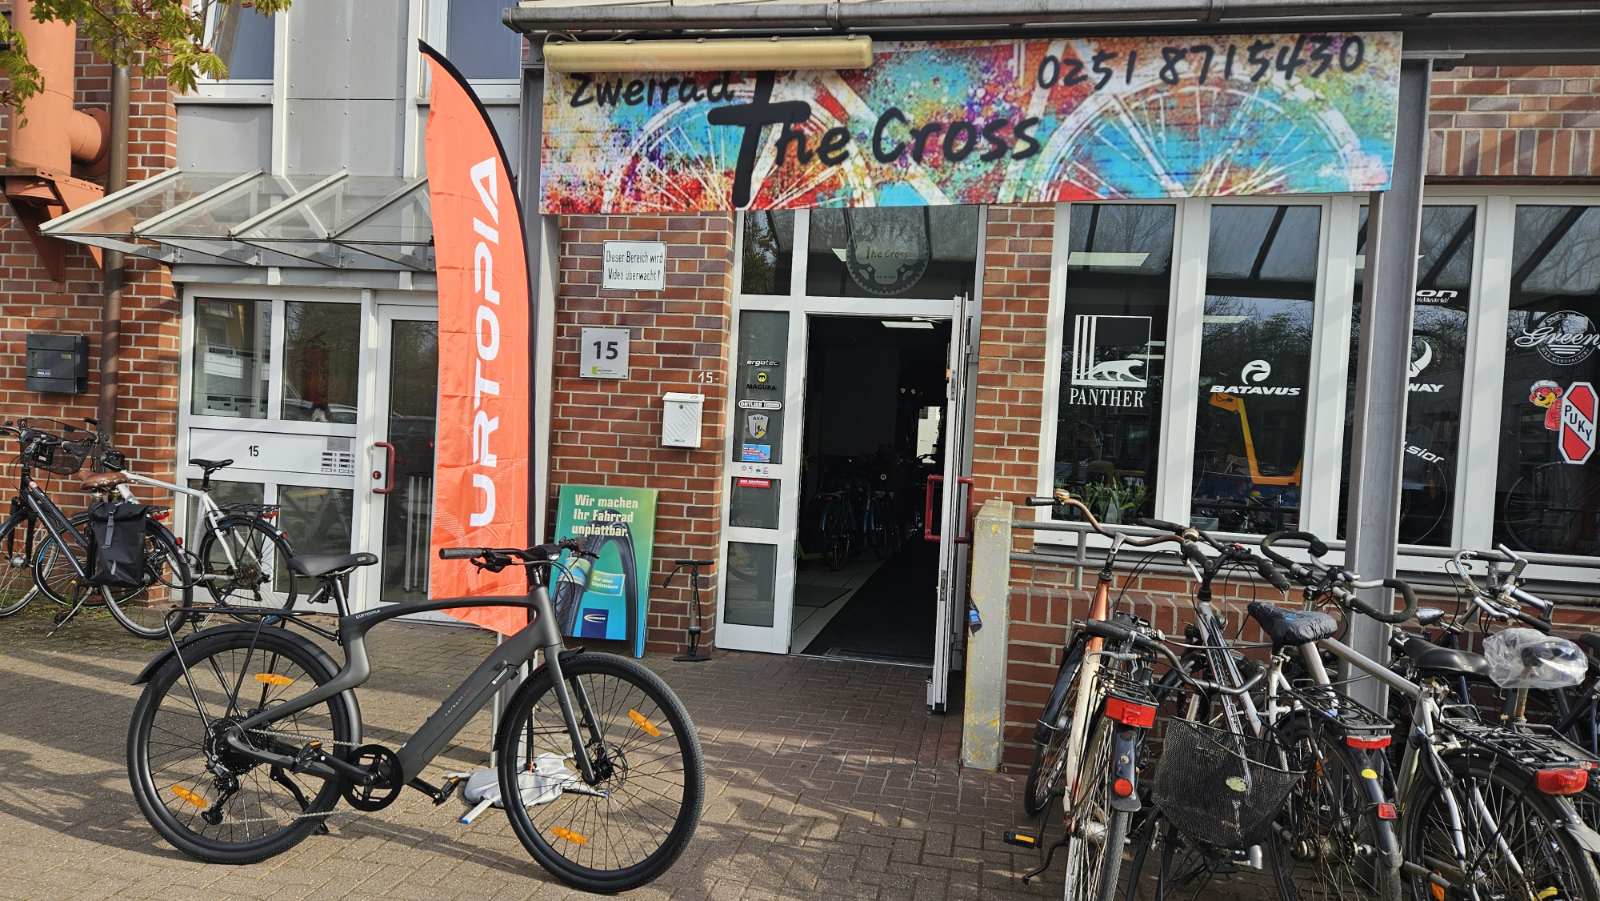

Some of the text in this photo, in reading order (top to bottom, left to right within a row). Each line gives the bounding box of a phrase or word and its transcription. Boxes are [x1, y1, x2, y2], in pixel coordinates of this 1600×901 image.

[1037, 35, 1366, 91] 0251 8715430
[569, 70, 736, 108] Zweirad
[707, 70, 1042, 208] The Cross
[626, 250, 649, 264] Bereich
[469, 156, 500, 527] URTOPIA
[593, 340, 619, 360] 15
[1068, 388, 1145, 408] PANTHER
[1209, 385, 1302, 396] BATAVUS
[1564, 405, 1593, 441] PUKY
[249, 445, 260, 457] 15
[575, 494, 639, 509] Wir machen
[573, 508, 634, 523] Ihr Fahrrad
[571, 524, 629, 537] unplattbar.
